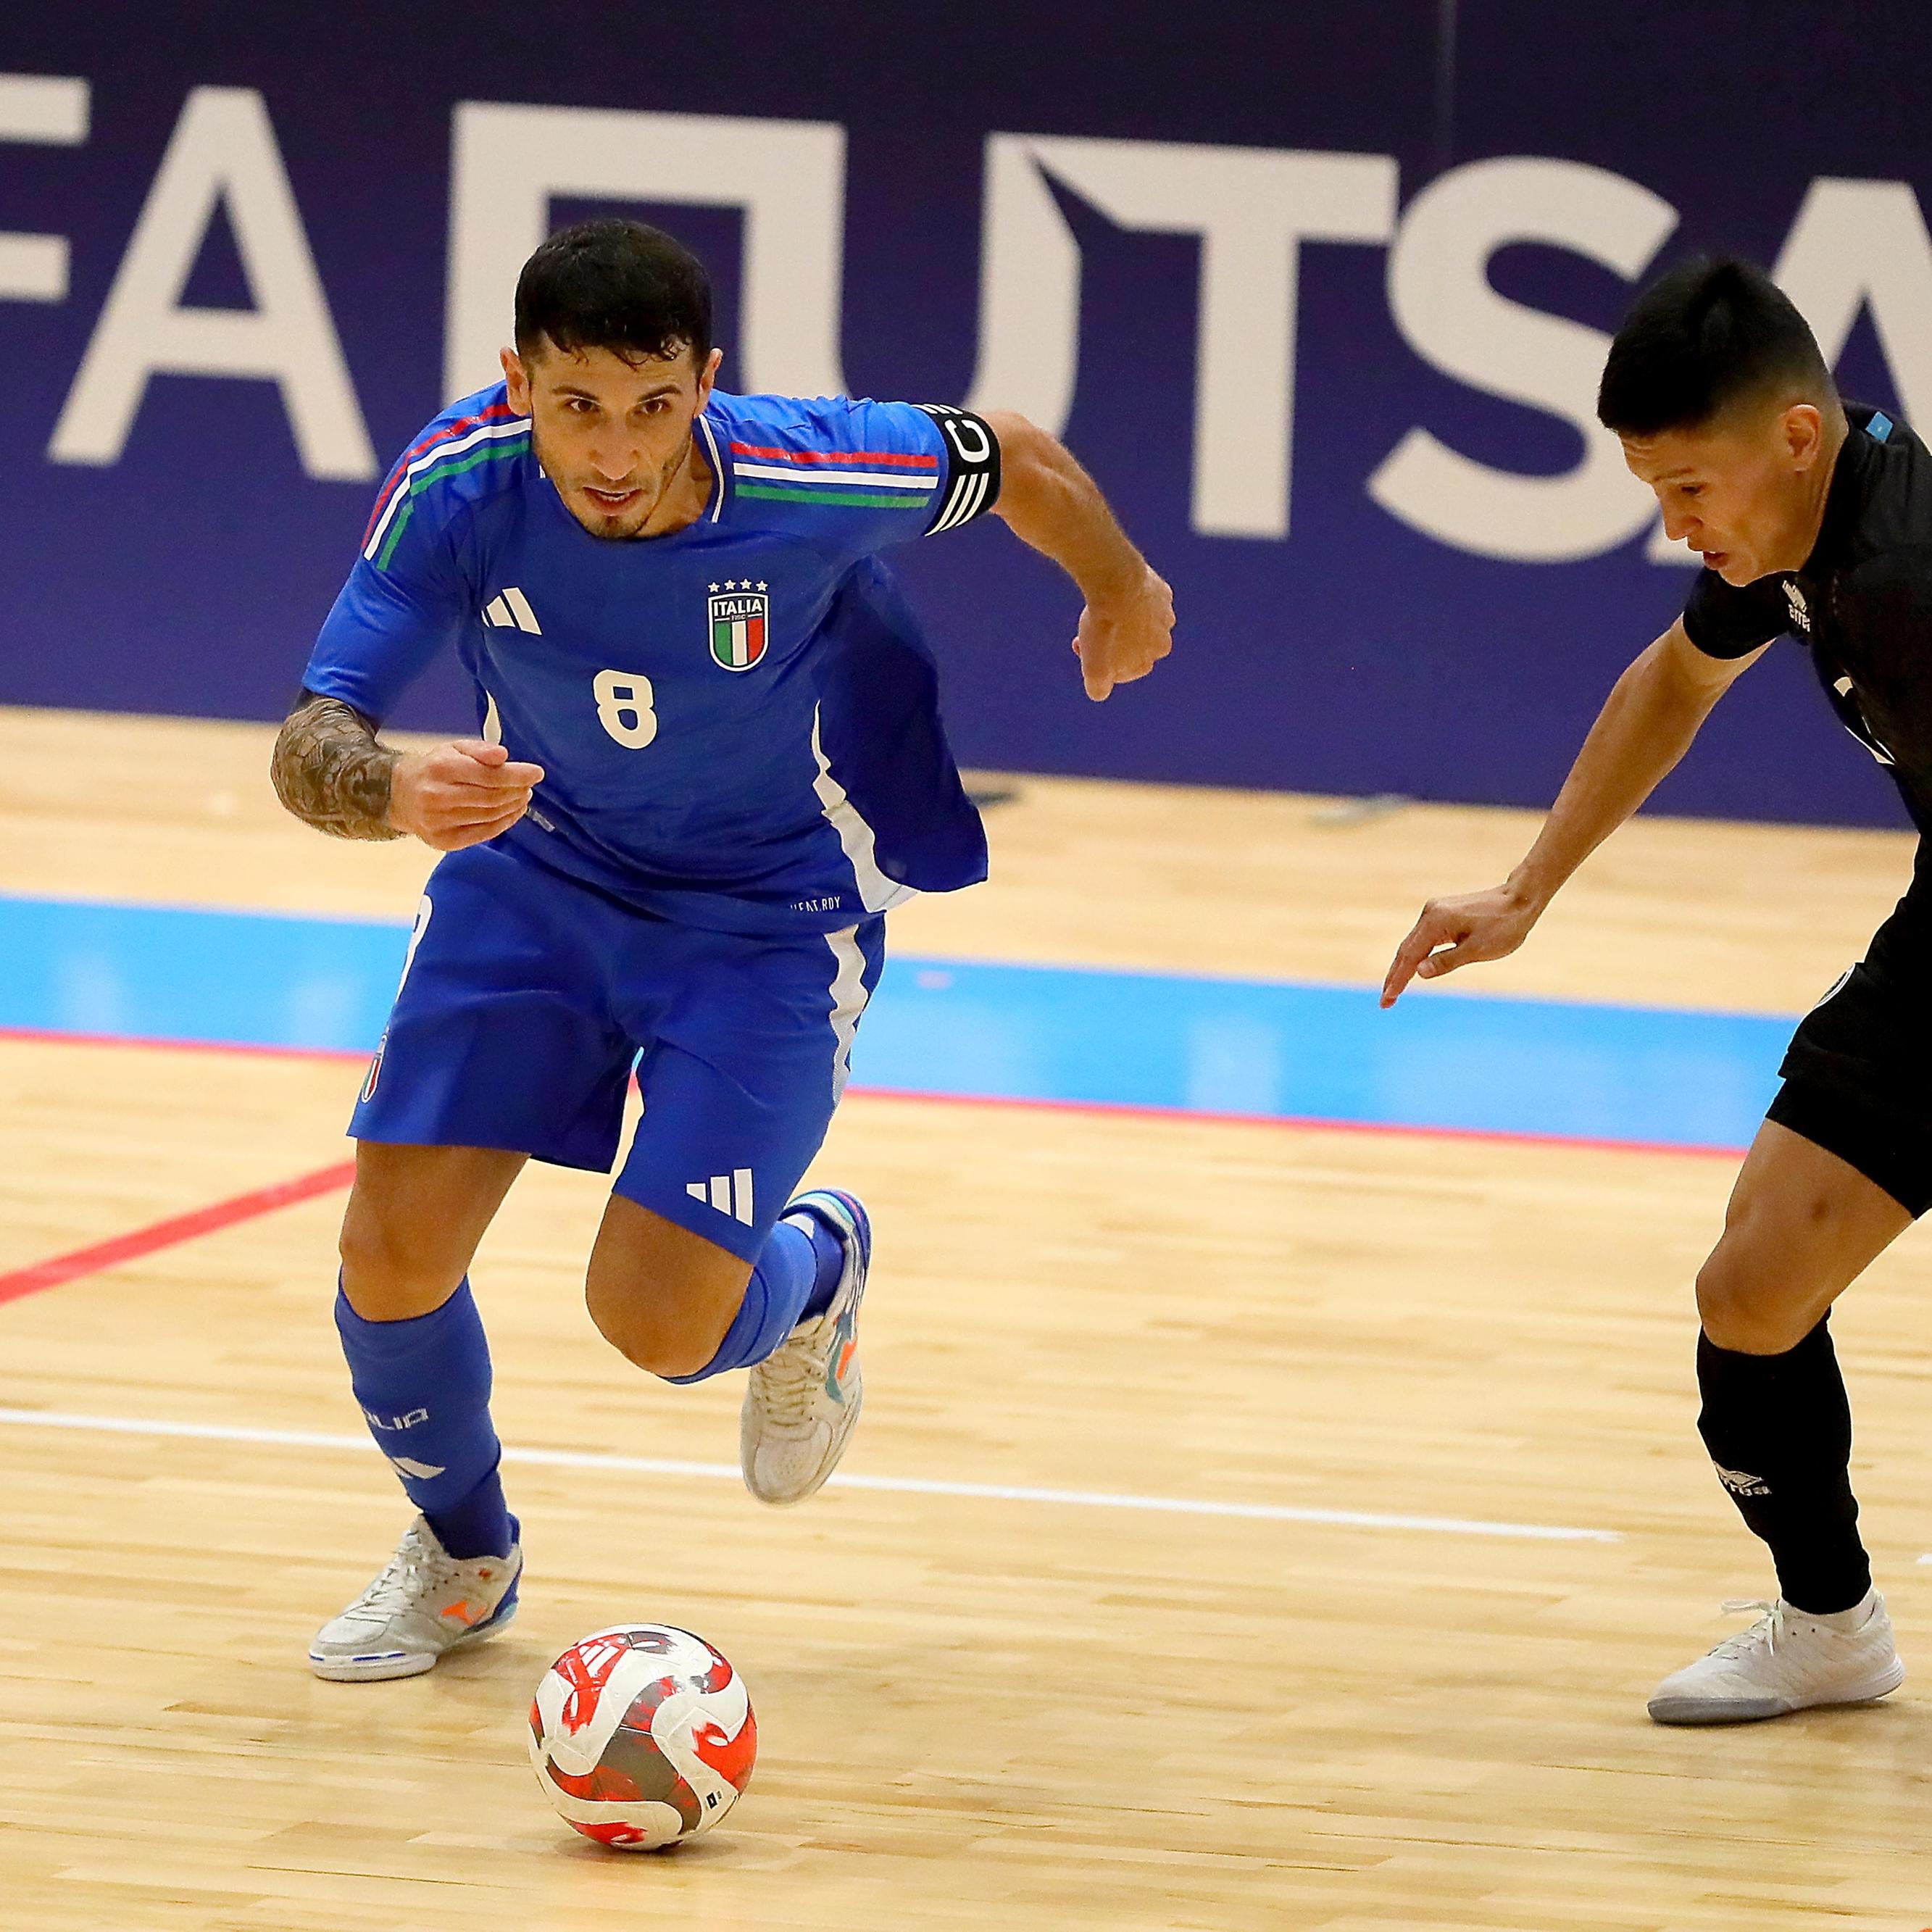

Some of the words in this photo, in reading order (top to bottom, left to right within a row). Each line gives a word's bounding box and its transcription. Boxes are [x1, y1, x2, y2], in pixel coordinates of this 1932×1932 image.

[944, 419, 990, 463] C
[713, 599, 763, 617] ITALIA
[593, 669, 658, 749] 8
